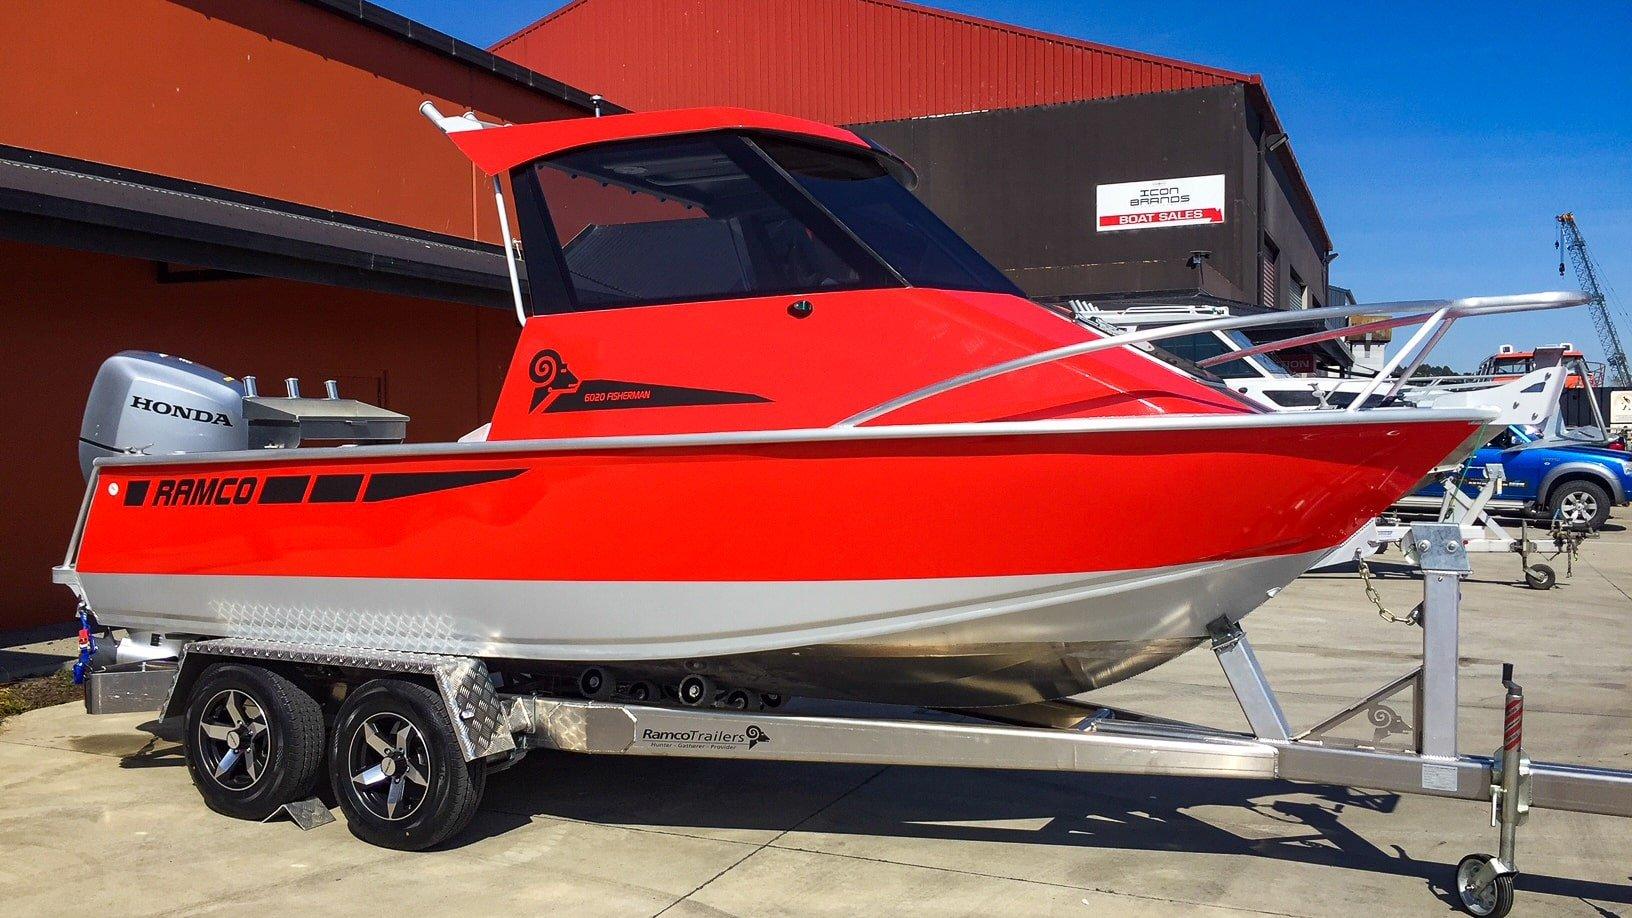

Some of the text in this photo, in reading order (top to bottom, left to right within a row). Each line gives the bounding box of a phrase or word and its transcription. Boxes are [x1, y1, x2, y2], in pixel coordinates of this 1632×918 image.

[1140, 187, 1179, 197] ICON
[1130, 195, 1190, 206] BRANDS
[1119, 210, 1203, 224] BOAT SALES
[584, 390, 650, 402] 6020 FISHERMAN
[130, 396, 233, 427] HONDA
[152, 477, 257, 506] RAMCO
[643, 728, 744, 742] RamcoTrailers
